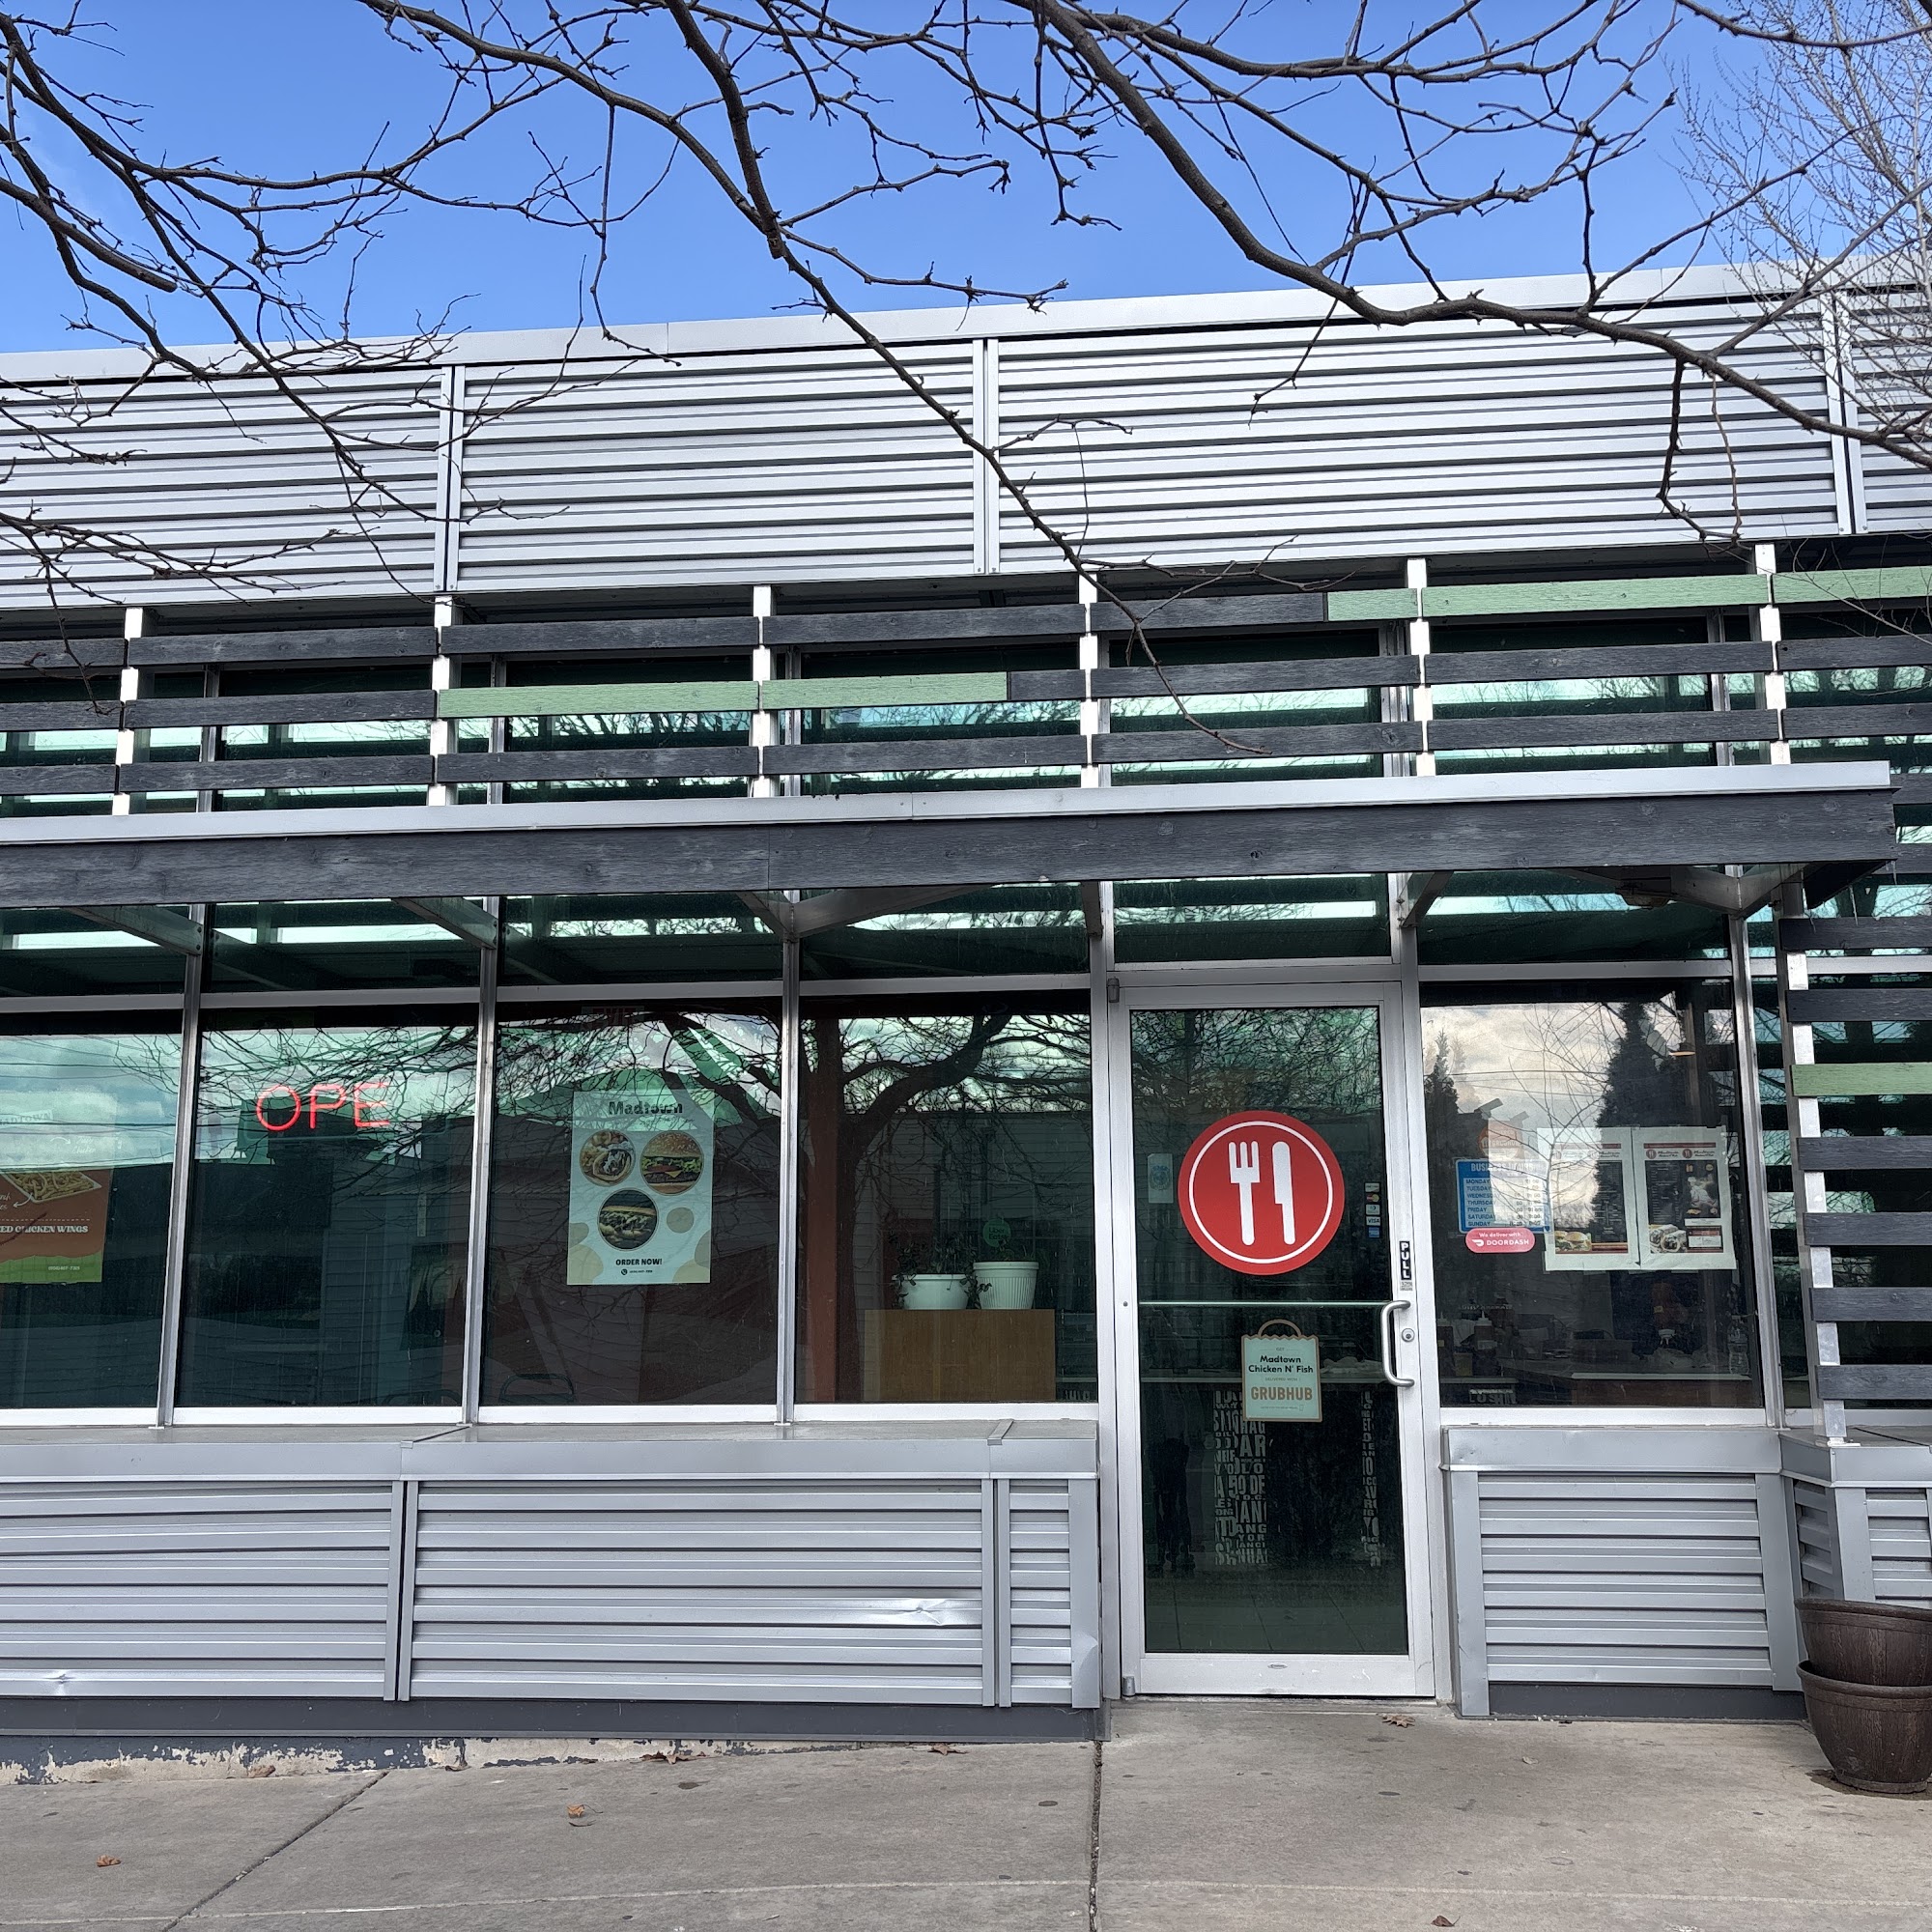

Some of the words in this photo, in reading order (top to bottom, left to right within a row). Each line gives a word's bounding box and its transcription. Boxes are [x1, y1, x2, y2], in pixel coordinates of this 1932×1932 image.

[609, 1101, 683, 1115] Madtown
[1471, 1163, 1506, 1172] BUSIESS
[1401, 1242, 1410, 1278] PULL
[1251, 1386, 1313, 1401] GRUBHUB
